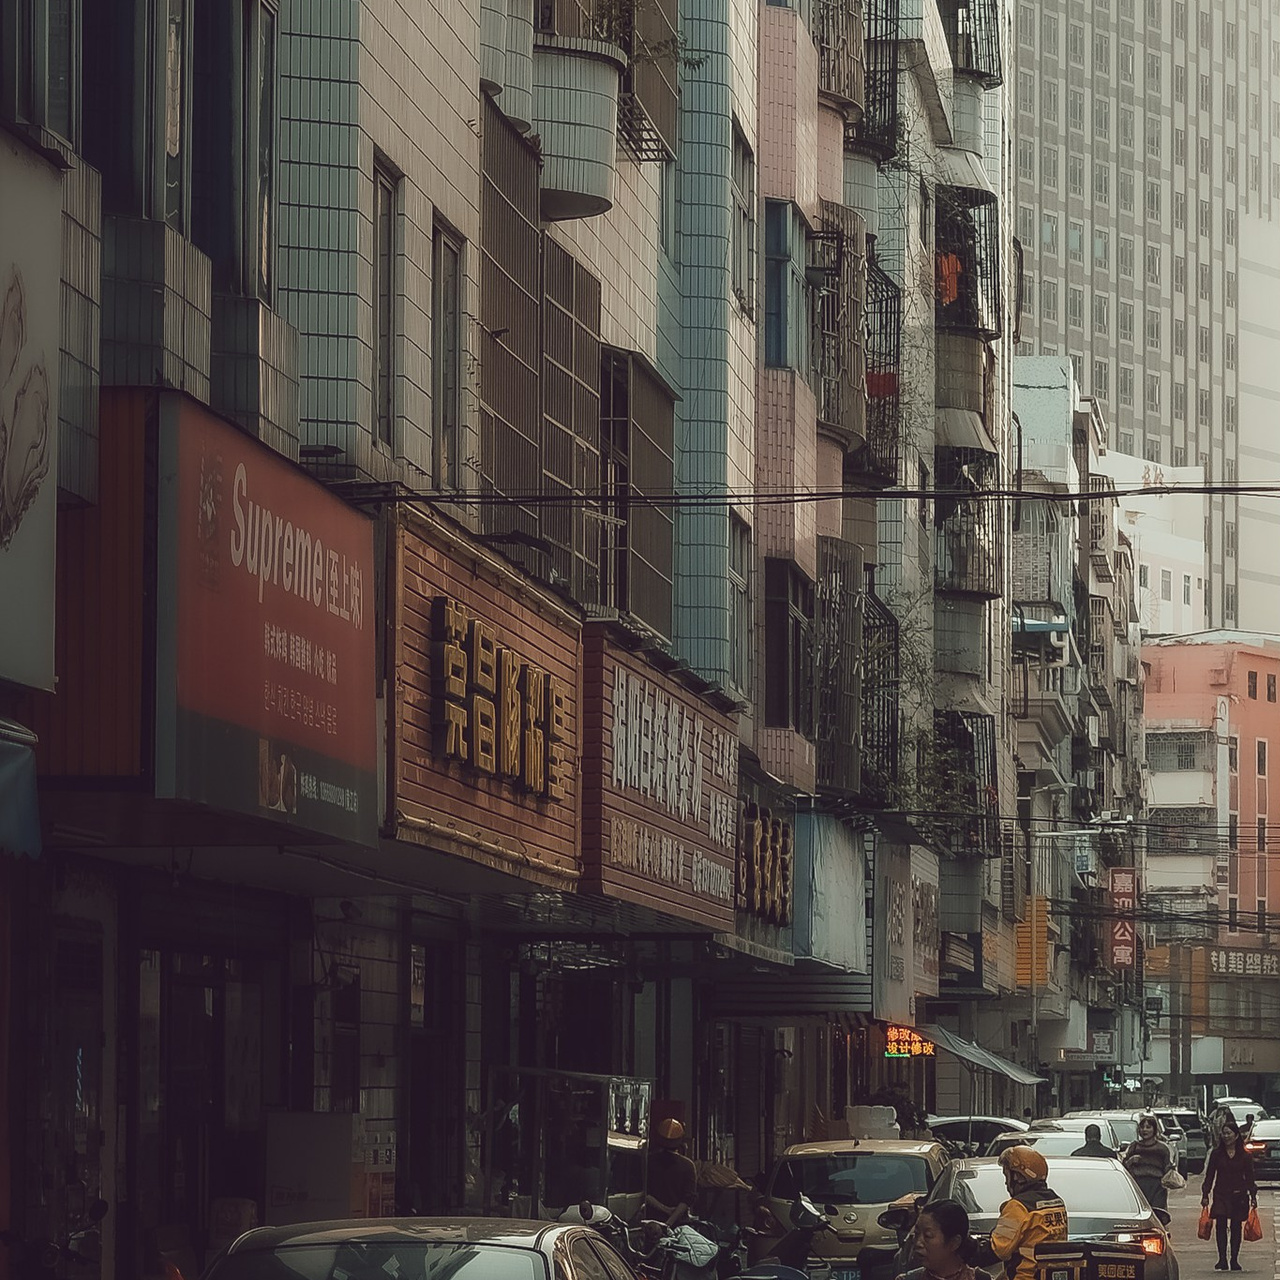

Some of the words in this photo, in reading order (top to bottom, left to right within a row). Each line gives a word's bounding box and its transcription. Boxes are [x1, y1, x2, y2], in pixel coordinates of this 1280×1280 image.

[231, 462, 323, 608] Supreme
[611, 664, 704, 824] 揭阳白塔粿条汤
[1113, 873, 1133, 965] 嘉迎公寓
[886, 1041, 936, 1056] 设计修改
[1093, 1031, 1111, 1053] 寓
